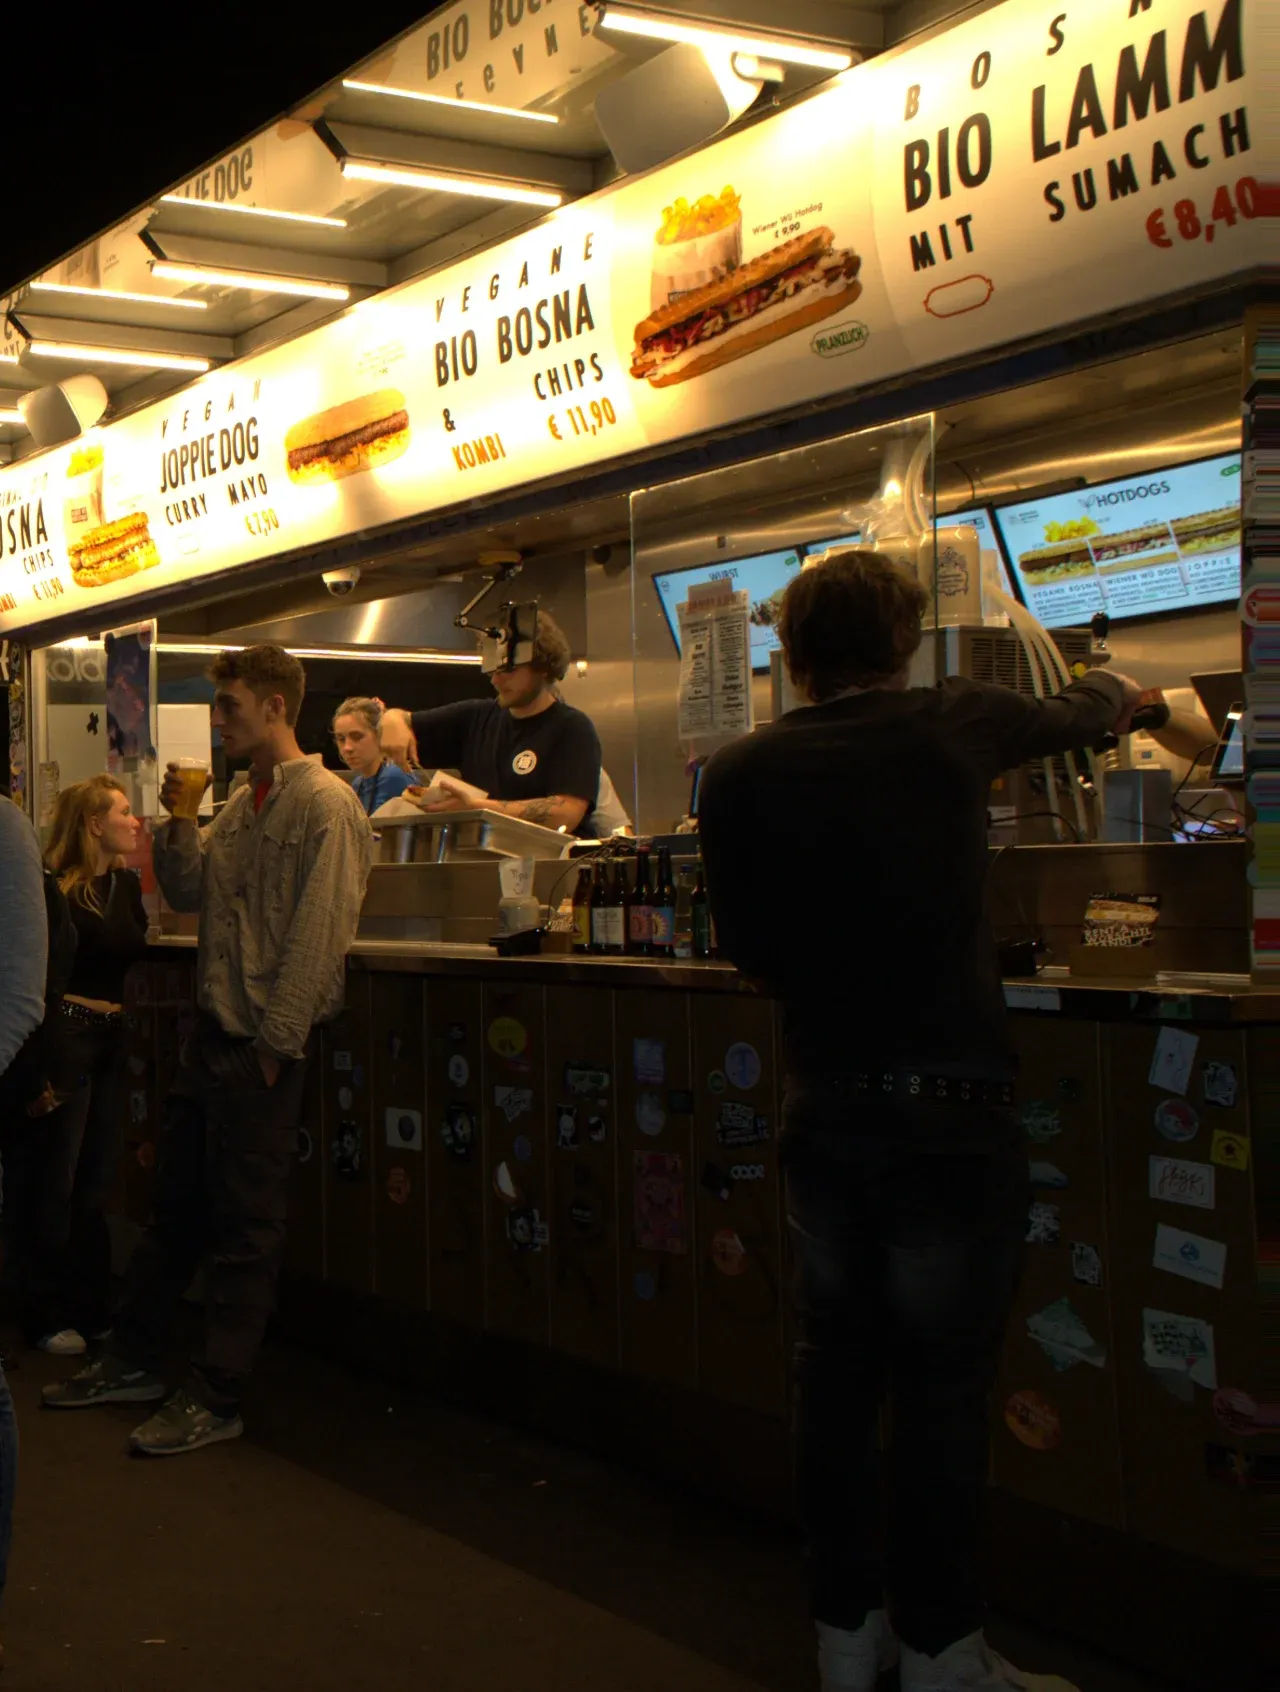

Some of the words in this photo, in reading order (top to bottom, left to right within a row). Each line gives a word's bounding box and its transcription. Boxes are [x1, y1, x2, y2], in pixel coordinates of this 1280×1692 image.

[904, 112, 992, 213] BIO
[1031, 0, 1246, 163] LAMM
[910, 213, 974, 272] MIT
[1043, 106, 1251, 222] SUMACH
[435, 232, 595, 323] VEGANE
[435, 327, 478, 388] BIO
[497, 282, 595, 364] BOSNA
[161, 379, 261, 438] VEGAN
[443, 407, 456, 432] &
[533, 352, 604, 400] CHIPS
[160, 431, 217, 494] JOPPIE
[220, 415, 260, 471] DOG
[451, 432, 506, 472] KOMBI
[567, 396, 617, 437] 11,90
[165, 493, 208, 526] CURRY
[227, 472, 268, 507] MAYO
[1095, 480, 1171, 508] HOTDOGS
[23, 549, 54, 575] CHIPS
